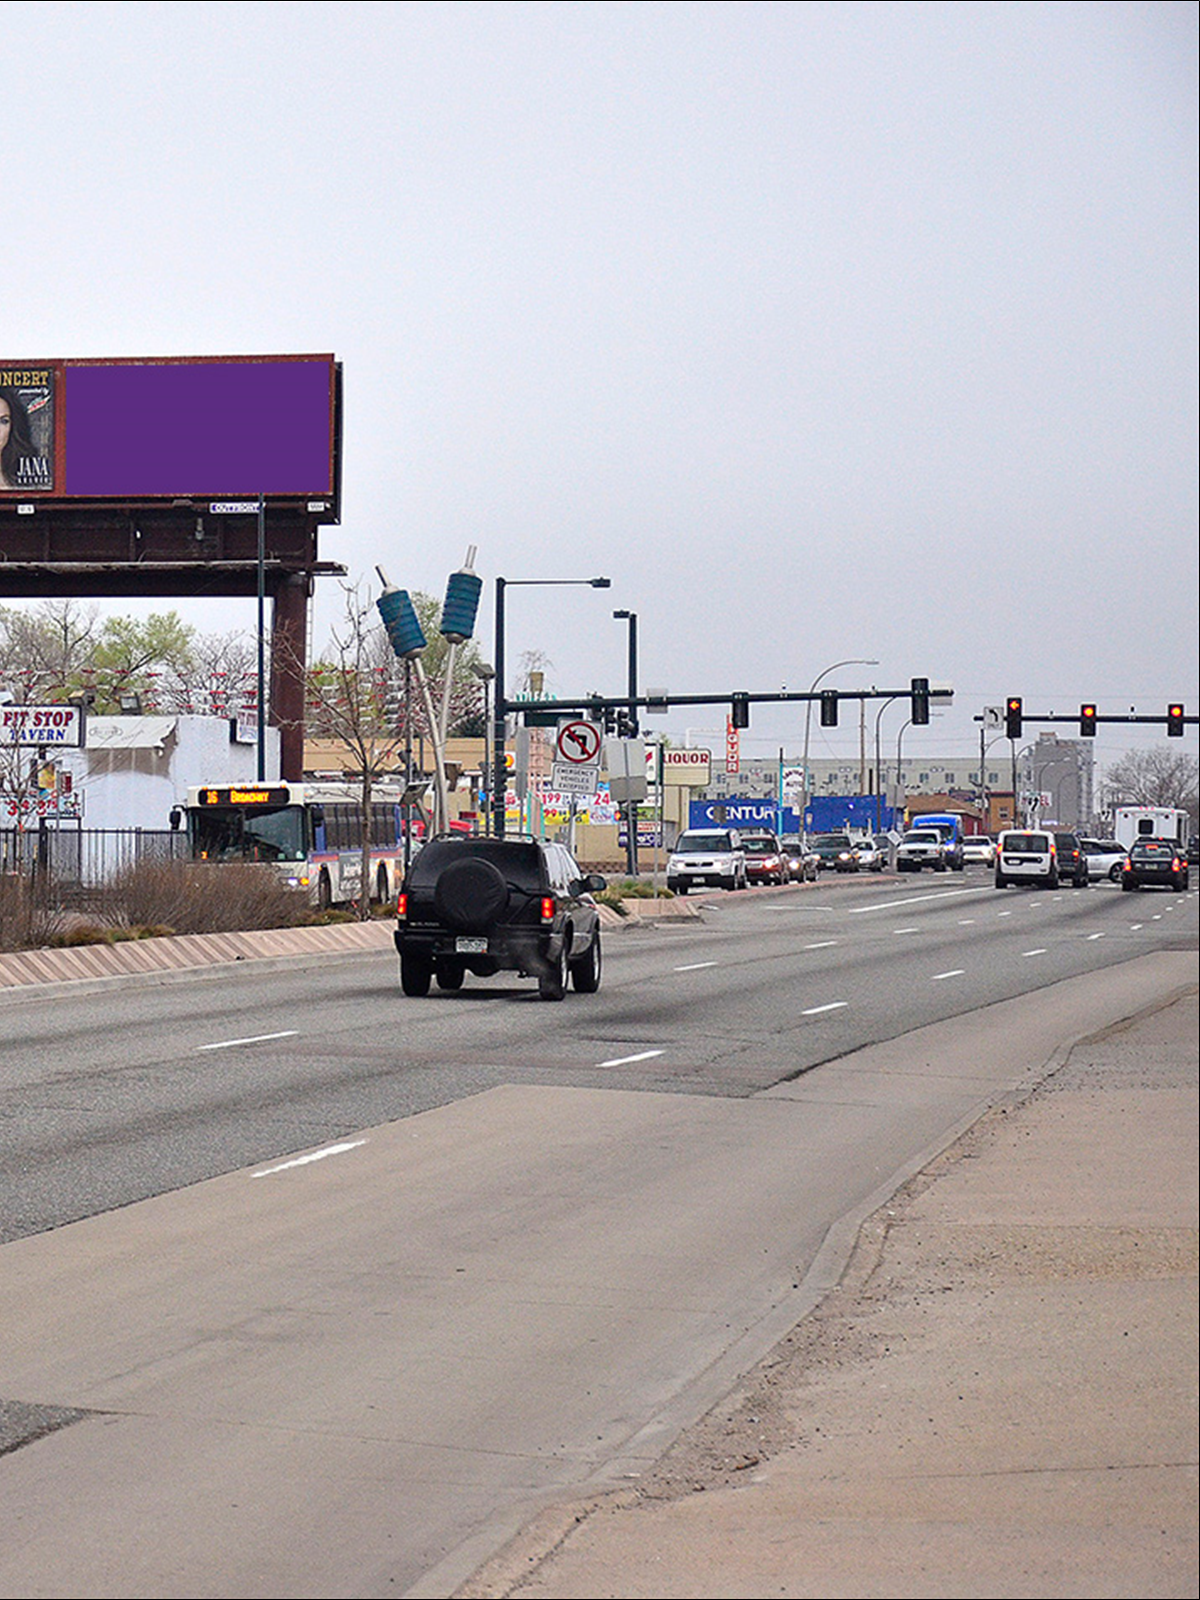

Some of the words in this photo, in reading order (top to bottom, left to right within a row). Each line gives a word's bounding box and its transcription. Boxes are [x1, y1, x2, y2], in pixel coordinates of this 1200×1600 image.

[17, 457, 48, 476] JANA
[3, 711, 29, 727] PIT
[33, 711, 74, 727] STOP
[10, 729, 66, 741] TAVERN
[663, 753, 709, 764] LIQUOR
